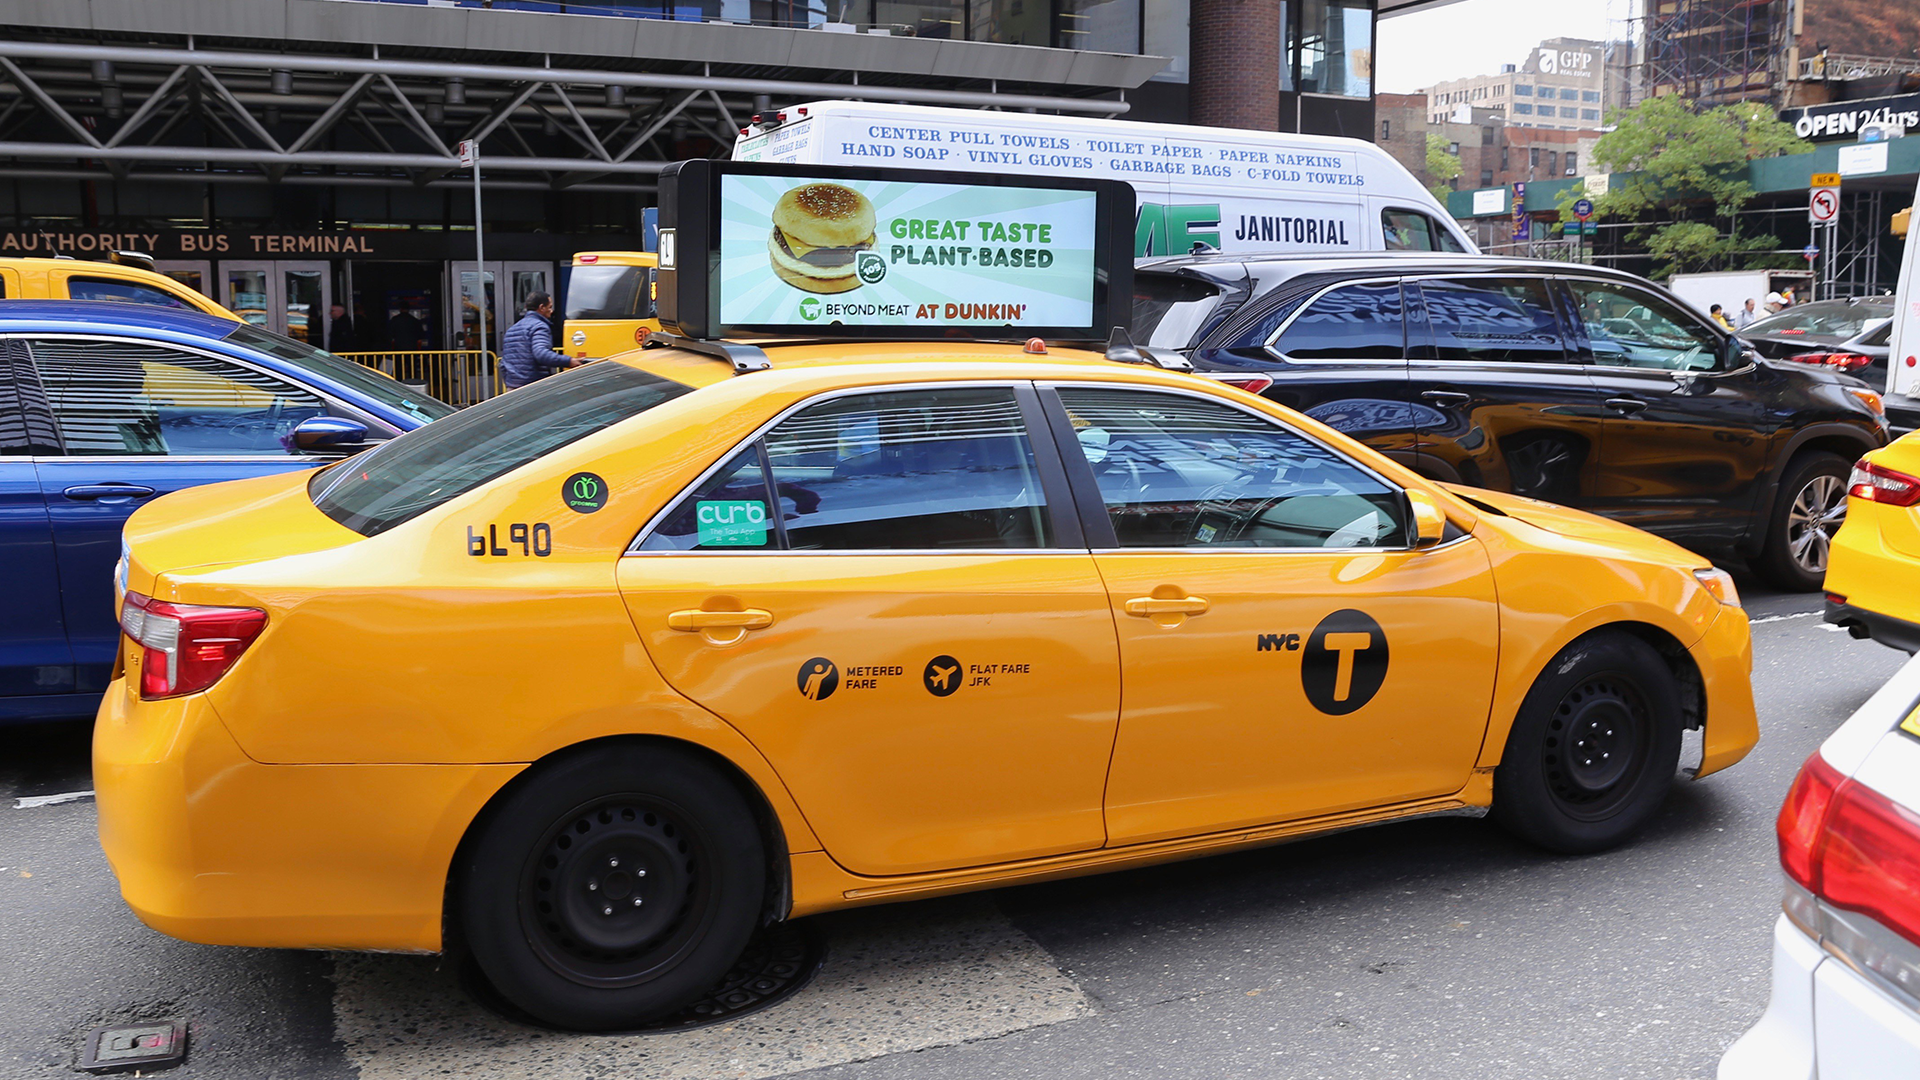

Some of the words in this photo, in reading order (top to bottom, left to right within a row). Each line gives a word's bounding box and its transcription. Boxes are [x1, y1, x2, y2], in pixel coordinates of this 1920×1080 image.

[1560, 51, 1592, 69] GFP
[1796, 111, 1857, 138] OPEN
[1858, 107, 1919, 134] 24hrs
[868, 126, 942, 142] CENTER
[949, 131, 994, 145] PULL
[1000, 134, 1070, 150] TOWELS
[1087, 140, 1144, 155] TOILET
[1151, 144, 1203, 159] PAPER
[1219, 150, 1269, 164] PAPER
[1275, 154, 1342, 169] NAPKINS
[841, 143, 896, 157] HAND
[903, 147, 949, 161] SOAP
[967, 150, 1022, 165] VINYL
[1028, 154, 1093, 169] GLOVES
[1110, 159, 1185, 174] GARBAGE
[1192, 165, 1232, 178] BAGS
[1247, 168, 1301, 183] C-FOLD
[1306, 172, 1365, 187] TOWELS
[1816, 175, 1836, 186] NEW
[890, 218, 970, 241] GREAT
[978, 221, 1052, 243] TASTE
[1235, 215, 1348, 246] JANITORIAL
[2, 233, 159, 251] AUTHORITY
[181, 234, 230, 252] BUS
[250, 235, 374, 253] TERMINAL
[863, 262, 881, 277] 10g
[826, 303, 876, 316] BEYOND
[878, 304, 910, 316] MEAT
[915, 304, 939, 319] AT
[944, 303, 1026, 320] DUNKIN'
[698, 503, 765, 524] curb
[740, 528, 756, 536] App
[847, 666, 903, 677] METERED
[970, 664, 998, 674] FLAT
[1001, 664, 1030, 674] FARE
[1257, 633, 1300, 652] NYC
[1324, 632, 1371, 702] T
[846, 679, 877, 689] FARE
[969, 677, 991, 687] JFK
